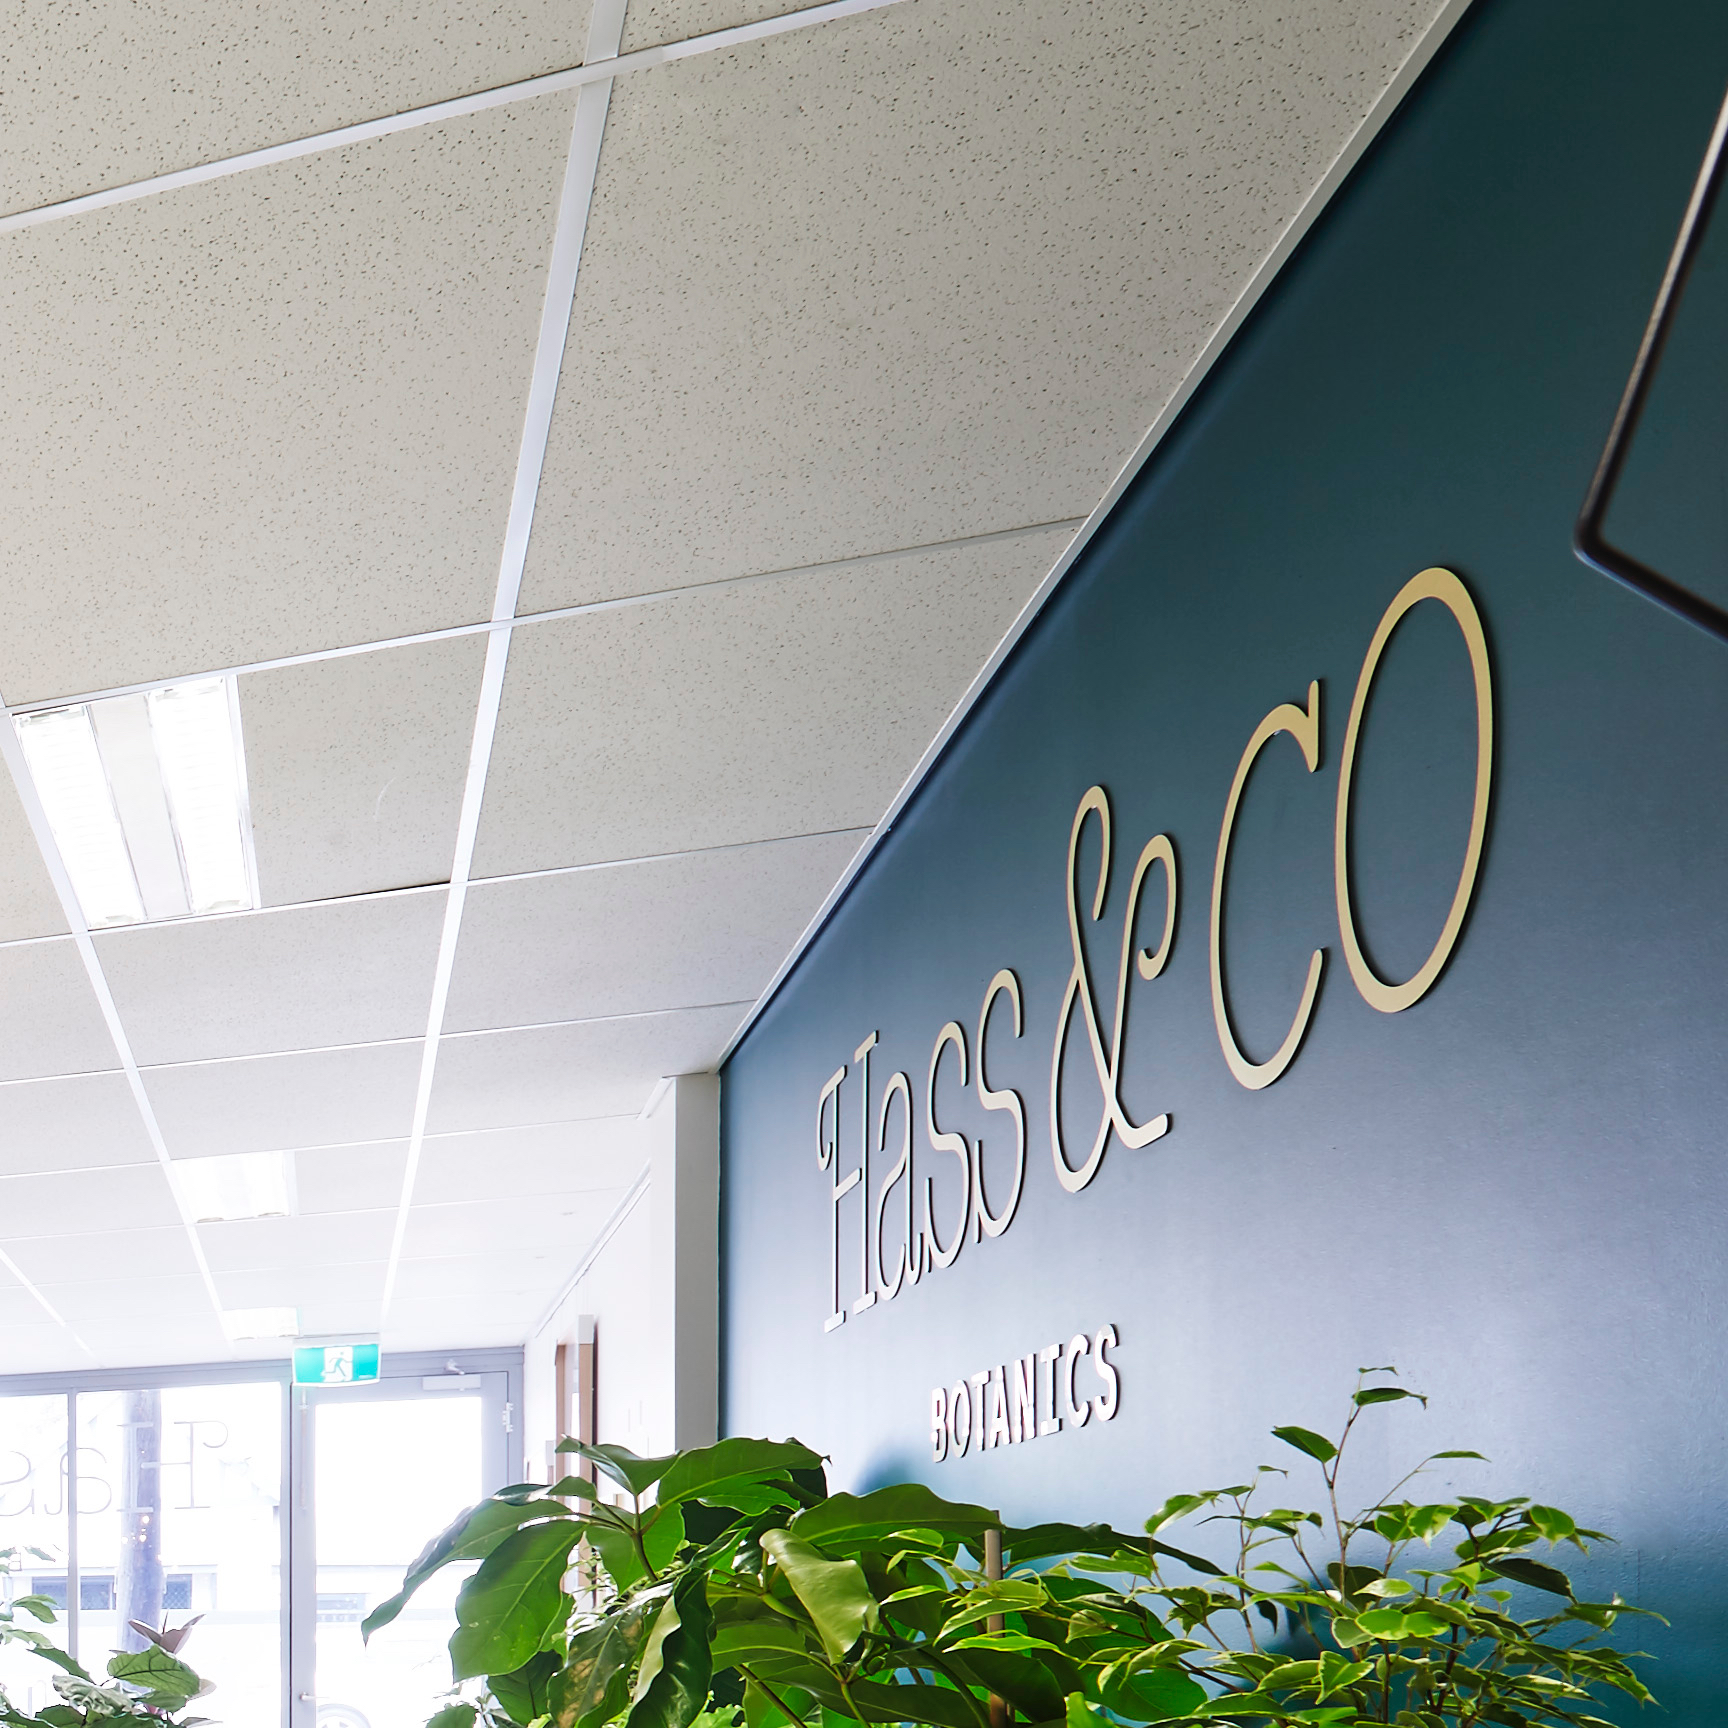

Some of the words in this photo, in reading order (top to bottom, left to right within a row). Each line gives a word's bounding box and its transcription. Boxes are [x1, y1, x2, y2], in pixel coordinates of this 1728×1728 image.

[816, 968, 1024, 1332] Hass
[1050, 786, 1177, 1192] &
[1210, 567, 1493, 1090] CO
[930, 1323, 1120, 1463] BOTANICS
